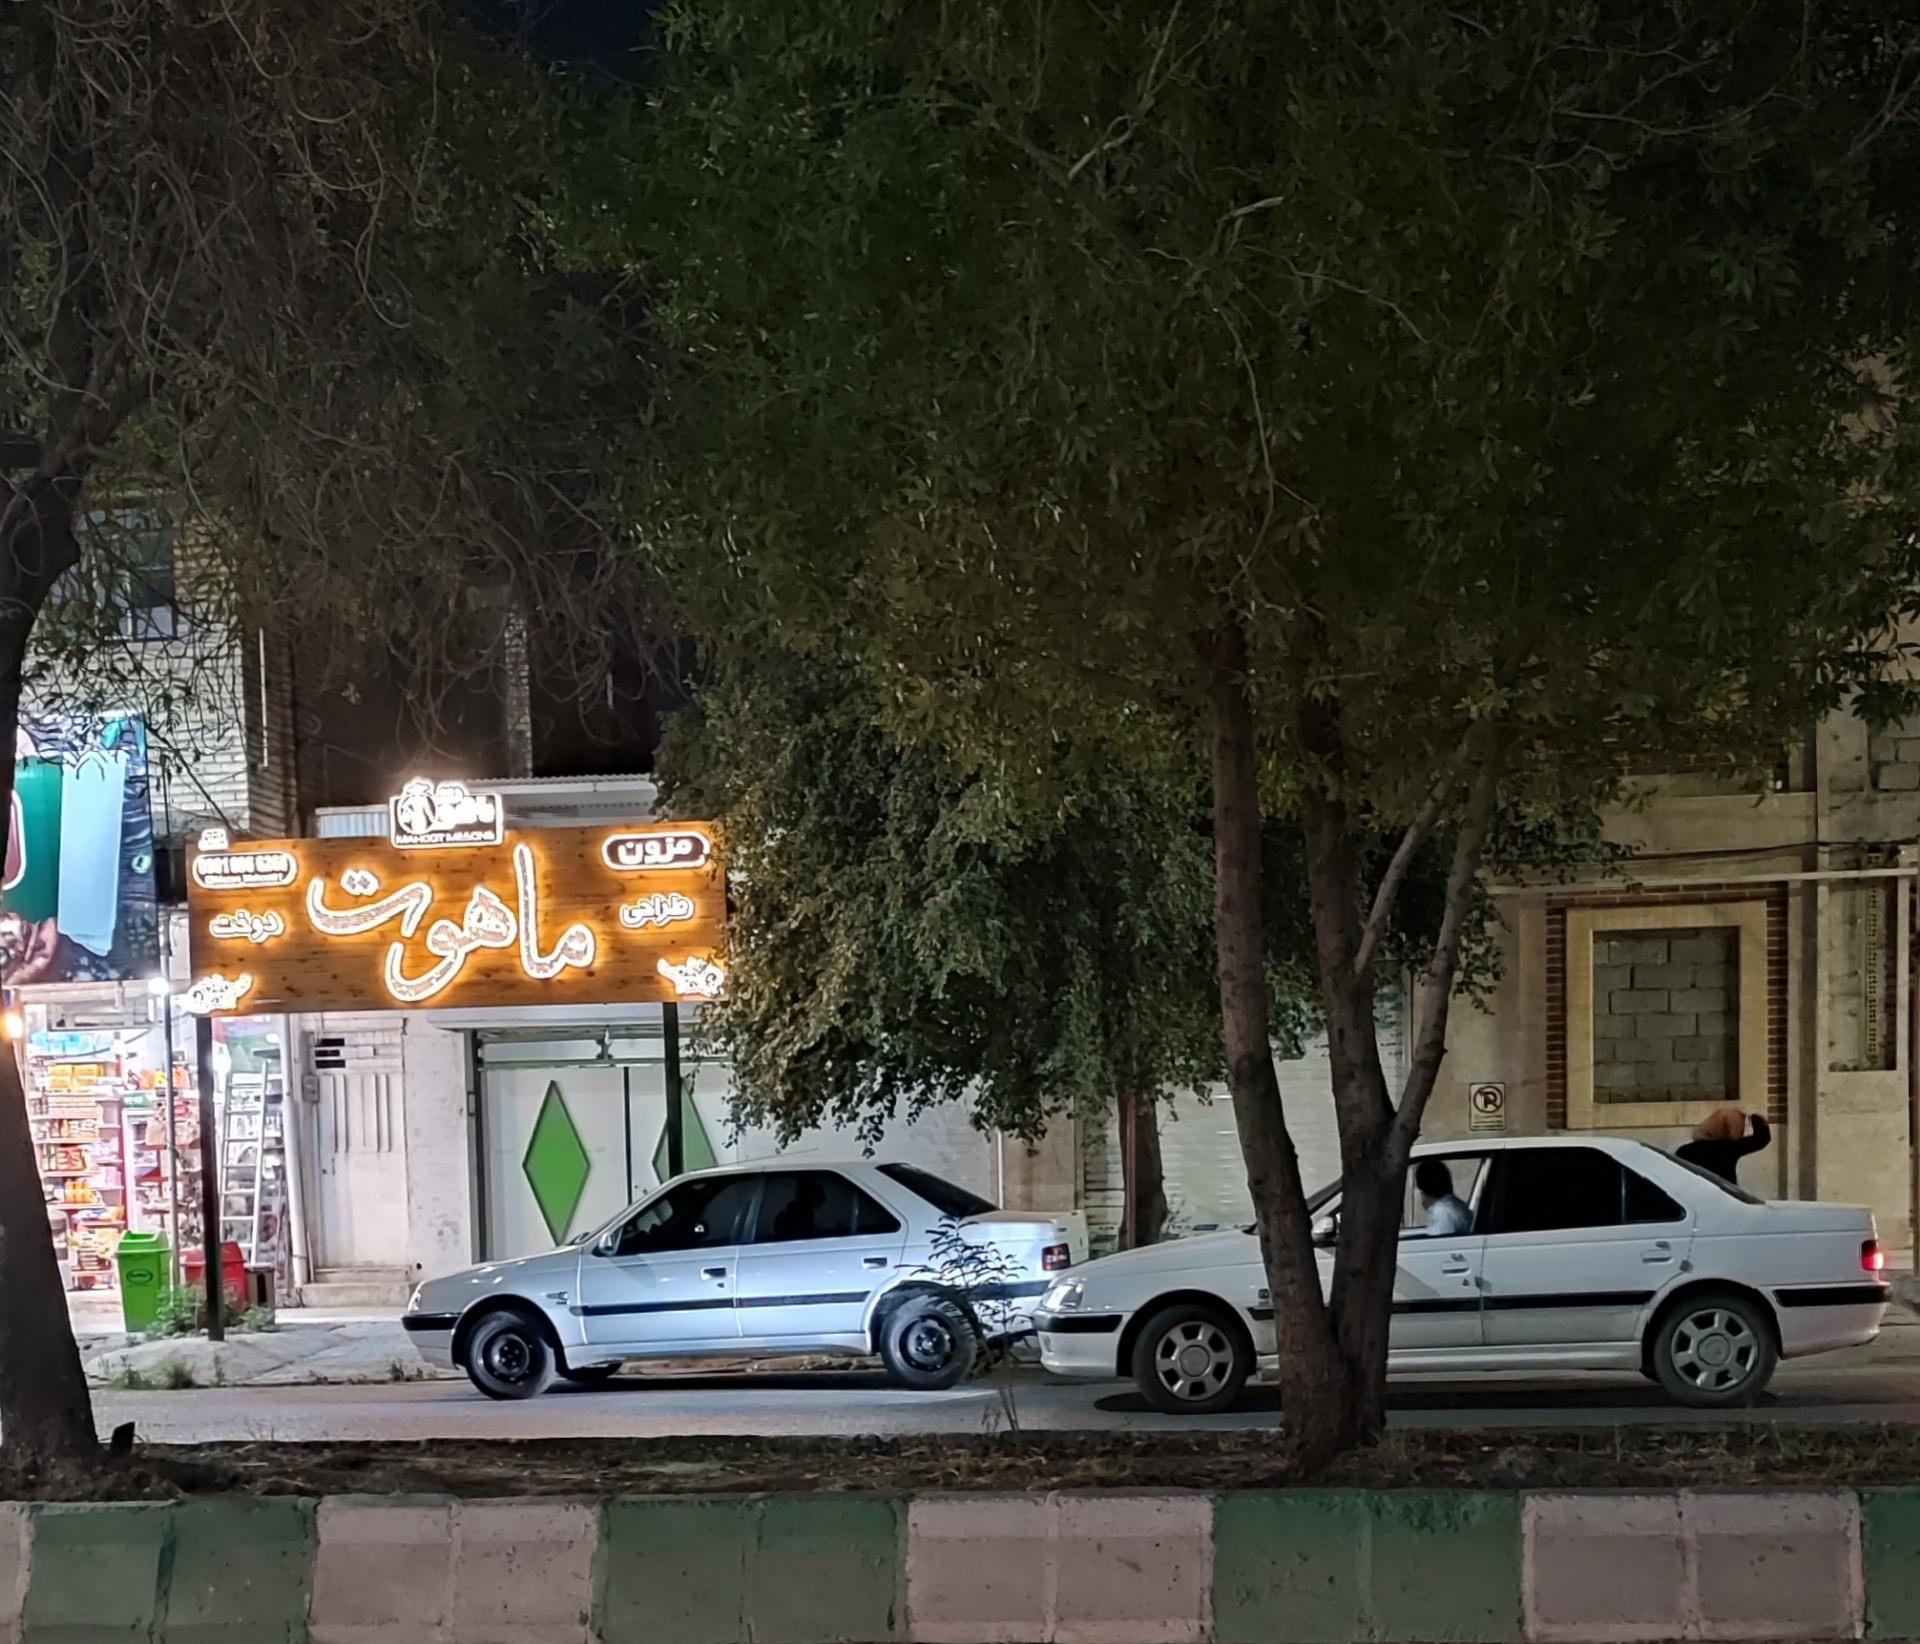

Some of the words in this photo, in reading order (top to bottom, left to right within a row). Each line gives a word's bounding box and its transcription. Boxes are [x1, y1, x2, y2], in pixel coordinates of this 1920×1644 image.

[618, 838, 693, 865] مزون
[211, 910, 282, 941] دوخت
[306, 843, 596, 1001] ماهوت
[621, 894, 692, 926] طراحی
